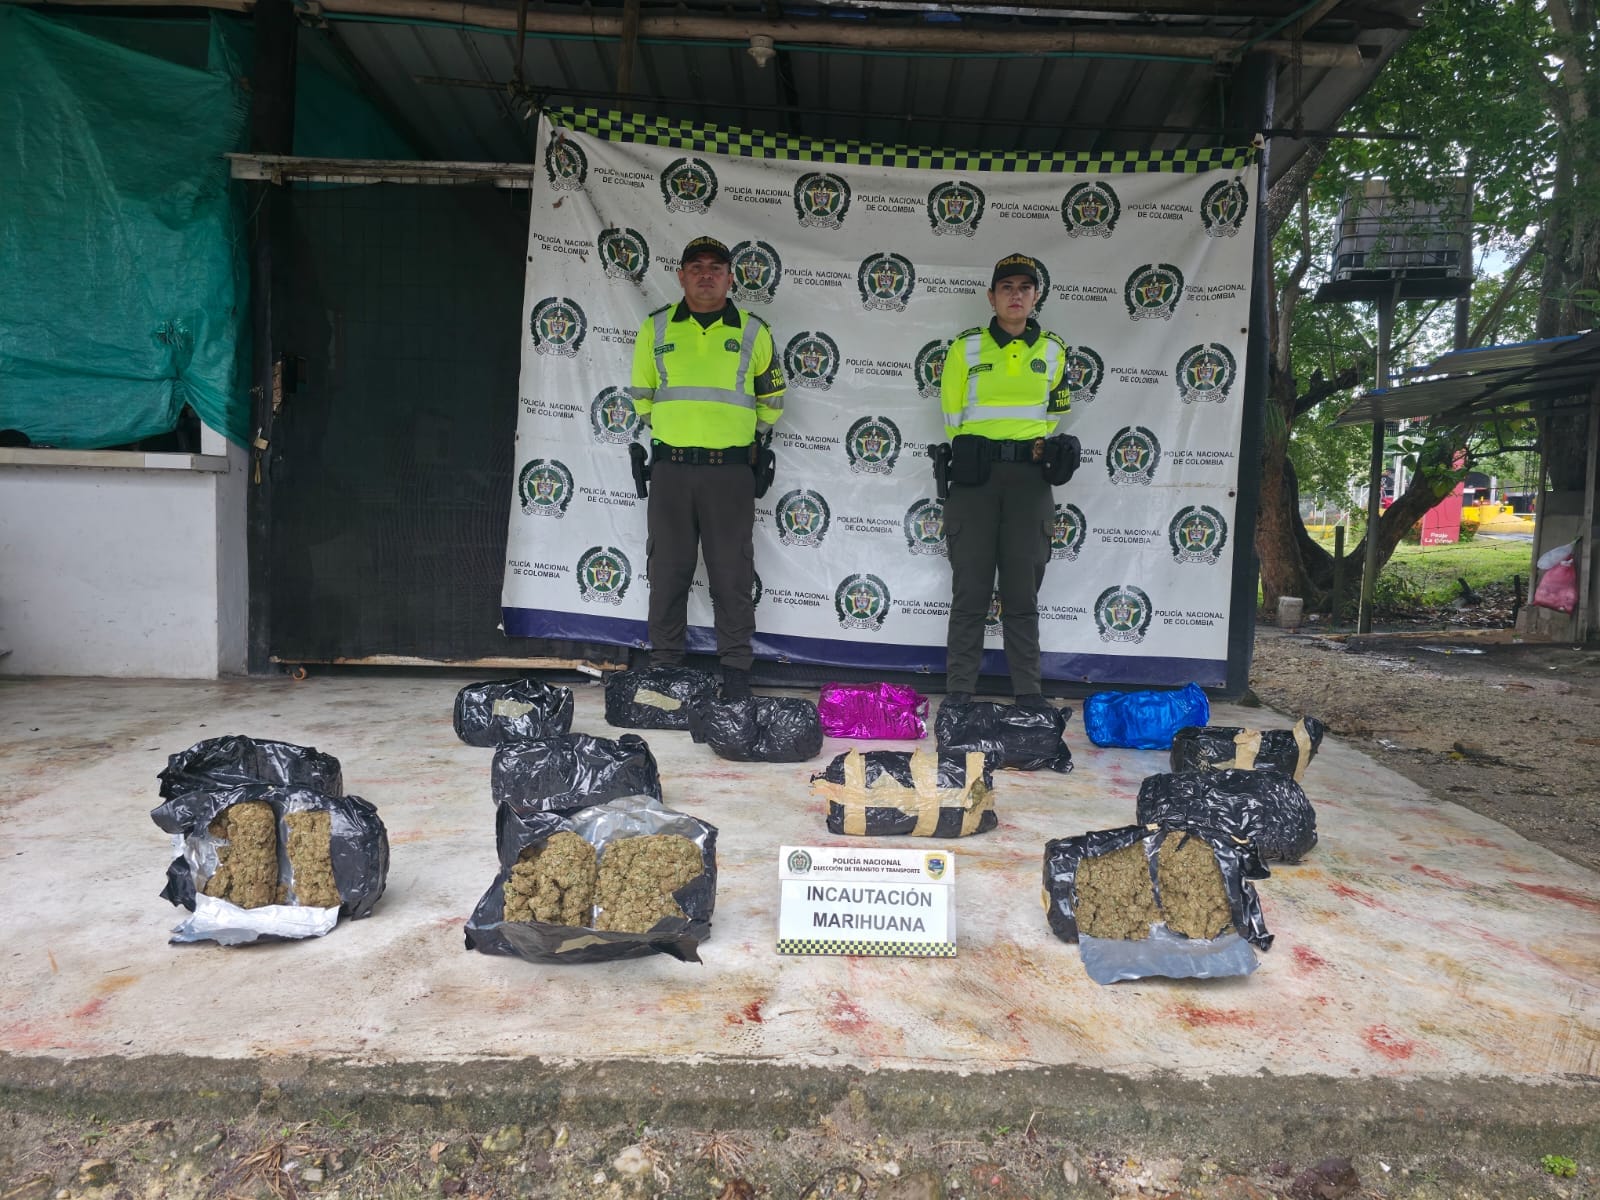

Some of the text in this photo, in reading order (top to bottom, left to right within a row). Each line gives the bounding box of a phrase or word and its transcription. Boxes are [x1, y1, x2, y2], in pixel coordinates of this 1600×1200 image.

[724, 186, 792, 197] POLICÍA NACIONAL
[744, 196, 782, 205] COLOMBIA
[858, 194, 926, 205] POLICÍA NACIONAL
[877, 205, 915, 213] COLOMBIA
[991, 202, 1060, 212] POLICÍA NACIONAL
[1160, 204, 1194, 212] NACIONAL
[1149, 212, 1183, 220] COLOMBIA
[533, 232, 561, 244] POLICÍA
[553, 245, 589, 255] COLOMBIA
[784, 268, 852, 279] POLICÍA NACIONAL
[804, 278, 842, 287] COLOMBIA
[918, 277, 986, 287] POLICÍA NACIONAL
[938, 287, 976, 295] COLOMBIA
[1052, 284, 1117, 294] POLICÍA NACIONAL
[1208, 284, 1246, 292] NACIONAL
[1071, 294, 1107, 302] COLOMBIA
[1196, 292, 1235, 301] COLOMBIA
[593, 326, 619, 334] POLICÍA
[845, 358, 912, 369] POLICÍA NACIONAL
[866, 368, 903, 376] COLOMBIA
[1111, 366, 1137, 375] POLICÍA
[549, 403, 584, 412] NACIONAL
[538, 409, 574, 419] COLOMBIA
[775, 432, 840, 444] POLICÍA NACIONAL
[794, 442, 831, 451] COLOMBIA
[1185, 458, 1224, 466] COLOMBIA
[580, 487, 606, 496] POLICÍA
[599, 497, 635, 506] COLOMBIA
[837, 516, 902, 526] POLICÍA NACIONAL
[856, 526, 892, 534] COLOMBIA
[1092, 527, 1120, 536] POLICÍA
[1113, 536, 1150, 544] COLOMBIA
[535, 562, 570, 572] NACIONAL
[523, 570, 560, 578] COLOMBIA
[765, 588, 830, 601] POLICÍA NACIONAL
[784, 598, 820, 607] COLOMBIA
[1041, 613, 1078, 621] COLOMBIA
[1155, 610, 1182, 618] POLICÍA
[832, 857, 860, 865] POLICÍA
[807, 885, 932, 907] INCAUTACIÓN
[813, 912, 925, 933] MARIHUANA
